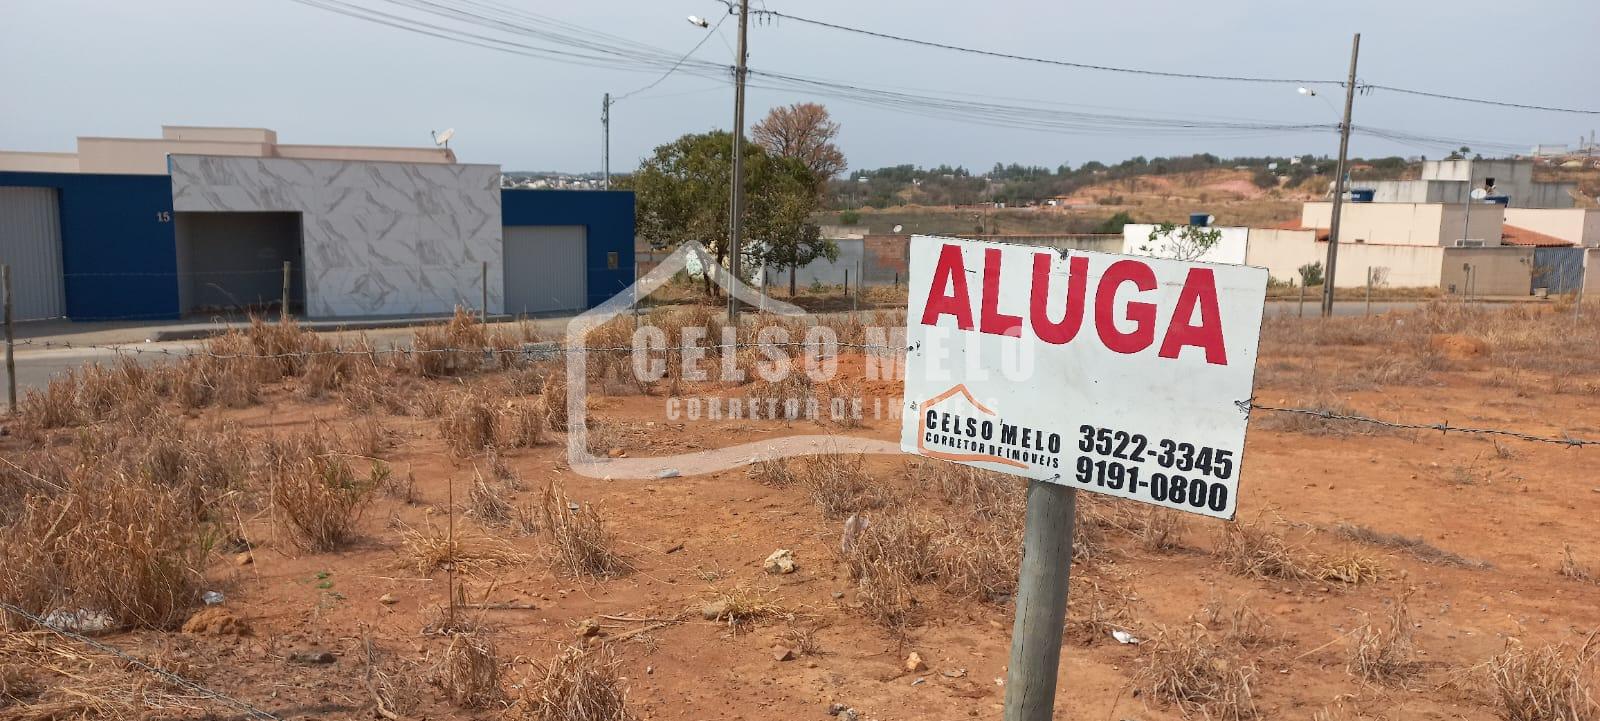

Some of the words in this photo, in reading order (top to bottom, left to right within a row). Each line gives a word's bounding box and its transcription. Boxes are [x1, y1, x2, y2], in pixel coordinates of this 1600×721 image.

[157, 211, 170, 222] 15
[921, 243, 1228, 365] ALUGA
[925, 409, 993, 440] CELSO
[1000, 423, 1061, 454] MELO
[925, 432, 985, 453] CORRETOR
[989, 445, 1002, 457] DE
[1078, 425, 1233, 480] 3522-3345
[1076, 456, 1228, 512] 9191-0800
